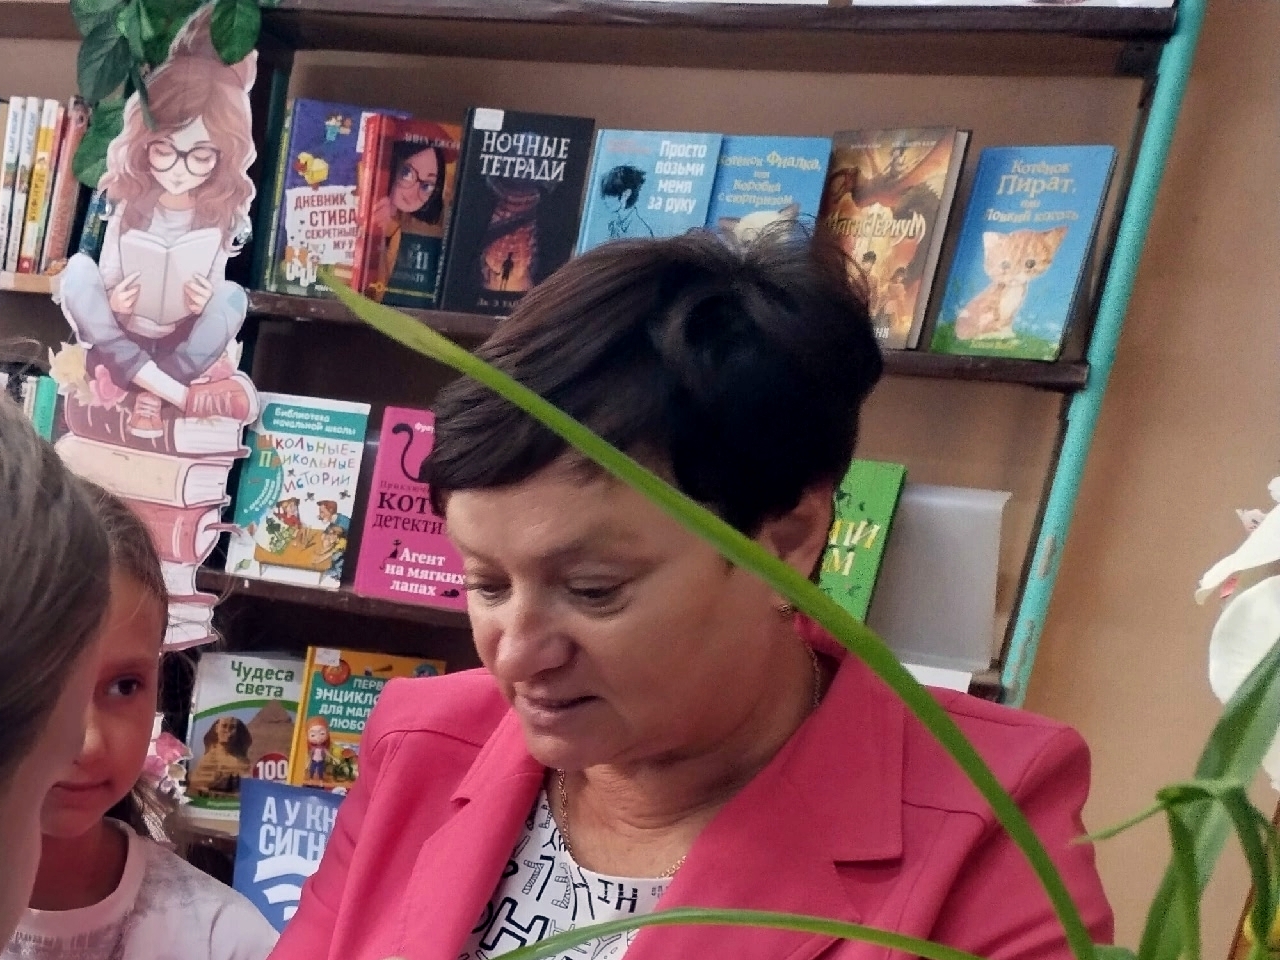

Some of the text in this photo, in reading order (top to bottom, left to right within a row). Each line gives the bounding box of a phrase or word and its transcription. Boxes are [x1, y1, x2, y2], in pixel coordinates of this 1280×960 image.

[482, 131, 571, 160] НОЧНЫЕ
[660, 140, 708, 160] Просто
[479, 154, 567, 182] ТЕТРАДИ
[654, 161, 705, 176] возьми
[658, 179, 693, 194] меня
[996, 174, 1076, 198] Пират,
[294, 192, 347, 211] ДНЕВНИК
[647, 196, 697, 215] за руку
[309, 208, 357, 228] СТИВА
[274, 407, 330, 423] Библиотека
[273, 419, 356, 435] начальной школы
[284, 471, 351, 493] ИСТОРИИ
[377, 491, 433, 517] КОТ
[372, 513, 445, 536] детекти
[399, 547, 446, 567] Агент
[384, 563, 465, 585] на мягких
[390, 579, 437, 597] лапах
[231, 660, 295, 682] Чудеса
[235, 683, 284, 698] света
[353, 678, 385, 691] ПЕРВ
[315, 688, 381, 705] ЭНЦИКЛО
[319, 704, 373, 718] ДЛЯ МАЛ
[330, 718, 366, 731] ЛЮБО
[256, 760, 288, 780] 100
[262, 797, 277, 824] А
[285, 799, 300, 826] У
[259, 824, 326, 861] СИГН
